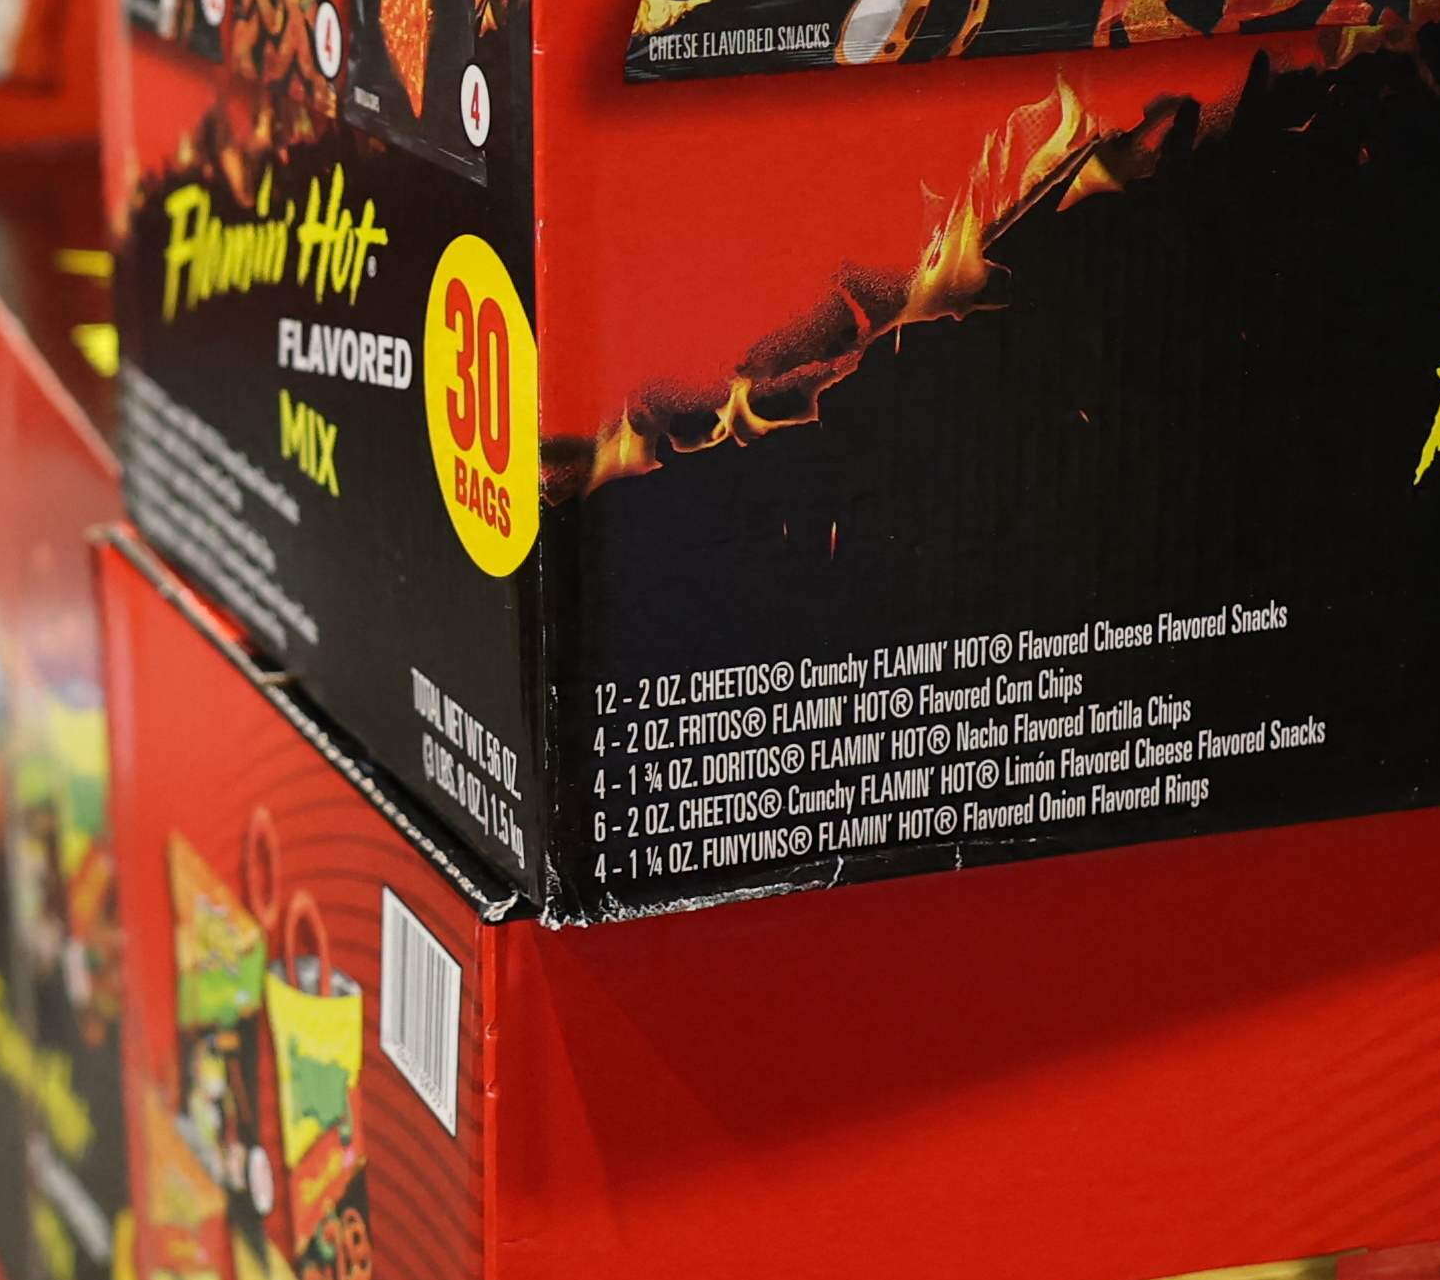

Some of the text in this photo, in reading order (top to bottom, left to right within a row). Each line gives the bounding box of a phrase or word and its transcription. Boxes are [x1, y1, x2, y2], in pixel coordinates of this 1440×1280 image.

[322, 26, 334, 68] 4
[649, 22, 831, 62] CHEESE FLAVORED SNACKS
[470, 81, 481, 130] 4
[163, 166, 291, 320] Flamin'
[279, 318, 413, 390] FLAVORED
[444, 278, 511, 475] 30
[279, 389, 340, 497] MIX
[453, 455, 512, 539] BAGS
[594, 682, 617, 715] 12
[638, 678, 650, 710] 2
[656, 674, 686, 707] OZ.
[800, 653, 868, 689] Crunchy
[873, 640, 948, 680] FLAMIN'
[1018, 624, 1089, 662] Flavored
[1094, 620, 1152, 652] Cheese
[1157, 606, 1226, 644] Flavored
[1231, 599, 1287, 634] Snacks
[593, 726, 605, 757] 4
[626, 722, 638, 754] 2
[645, 719, 675, 752] OZ.
[772, 696, 848, 735] FLAMIN'
[919, 678, 991, 716] Flavored
[996, 673, 1033, 705] Corn
[1038, 667, 1083, 703] Chips
[593, 769, 605, 800] 4
[629, 765, 637, 796] 1
[669, 758, 698, 790] OZ.
[810, 733, 886, 771] FLAMIN'
[956, 719, 1008, 752] Nacho
[1014, 706, 1084, 744] Flavored
[1089, 698, 1142, 733] Tortilla
[1147, 694, 1191, 729] Chips
[487, 731, 522, 801] 56 OZ.
[594, 811, 606, 842] 6
[627, 807, 639, 839] 2
[645, 803, 675, 836] OZ.
[788, 779, 856, 815] Crunchy
[860, 766, 935, 806] FLAMIN'
[1005, 753, 1055, 786] Limón
[1061, 742, 1130, 779] Flavored
[1135, 737, 1193, 770] Cheese
[1198, 722, 1265, 761] Flavored
[1270, 715, 1326, 750] Snacks
[594, 853, 606, 884] 4
[629, 849, 638, 879] 1
[669, 842, 698, 873] OZ.
[818, 817, 892, 853] FLAMIN'
[963, 794, 1034, 832] Flavored
[1039, 788, 1085, 822] Onion
[1091, 779, 1160, 816] Flavored
[1165, 774, 1209, 808] Rings
